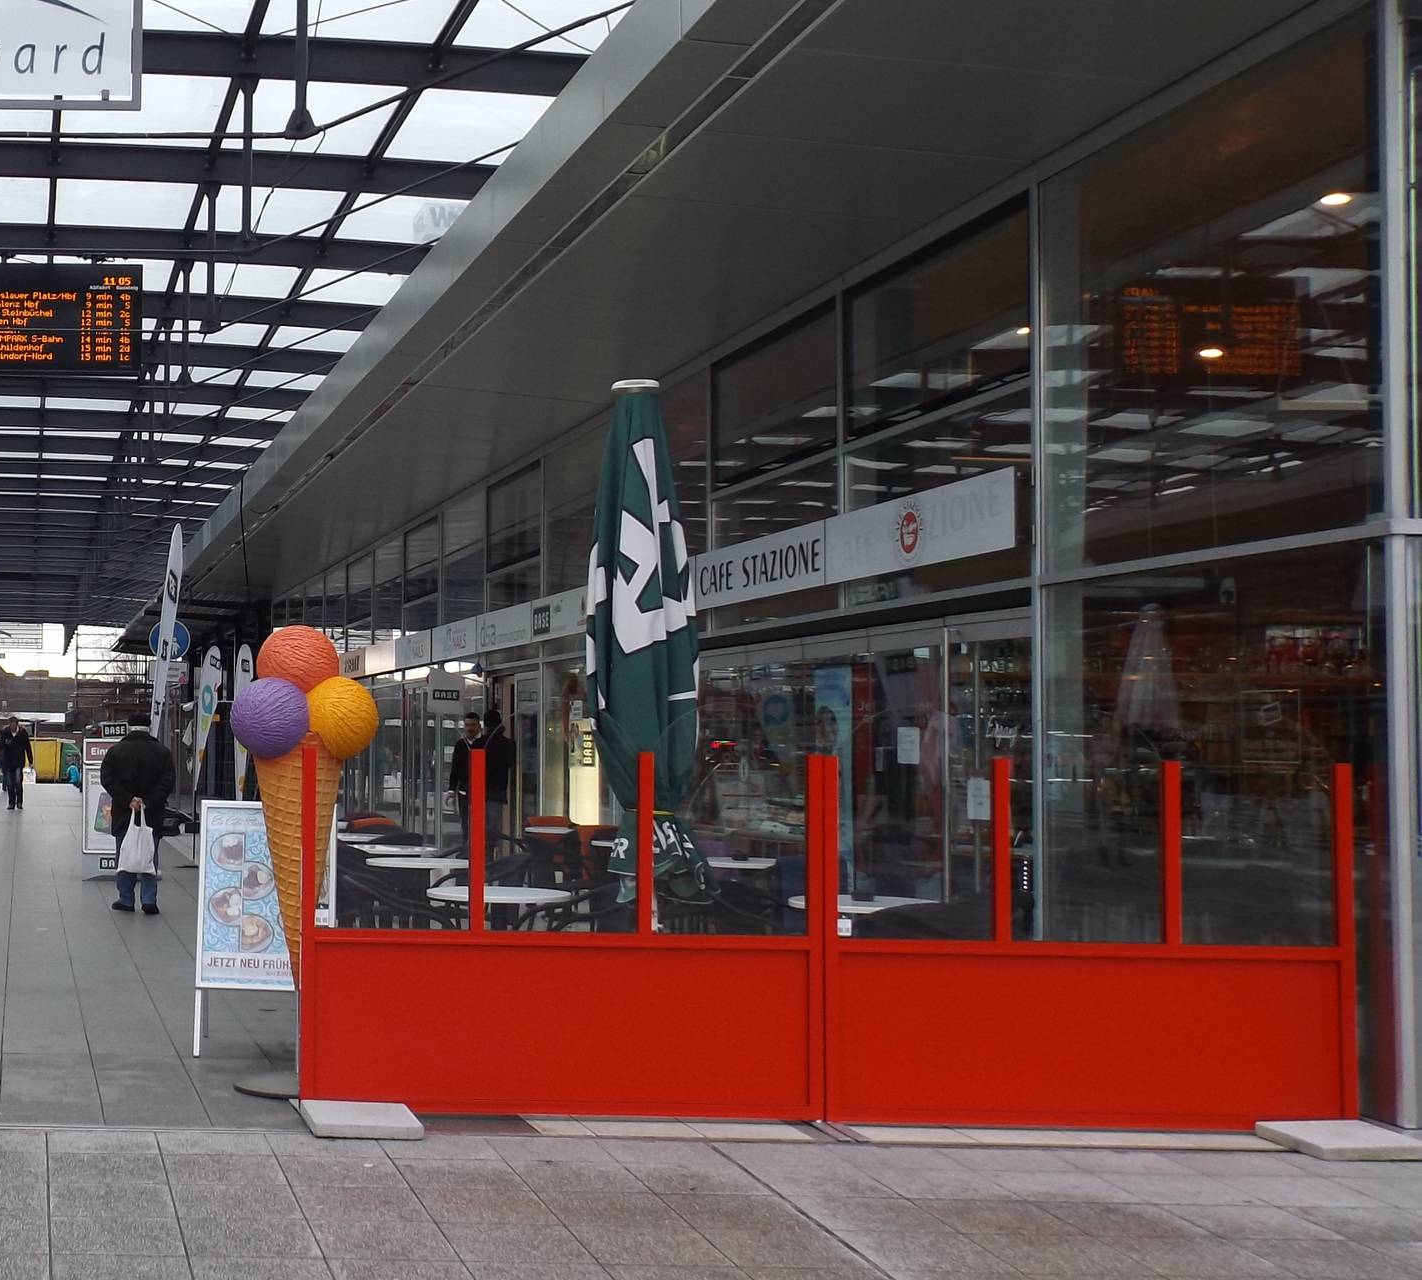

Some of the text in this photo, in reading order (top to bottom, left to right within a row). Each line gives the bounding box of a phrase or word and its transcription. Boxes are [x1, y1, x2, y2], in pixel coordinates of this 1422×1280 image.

[33, 292, 77, 301] Platz/Hbf
[24, 301, 39, 309] Hbf
[13, 318, 27, 326] Hbf
[699, 537, 821, 597] CAFE STAZIONE
[534, 611, 550, 631] BASE
[434, 690, 458, 699] BASE
[104, 725, 127, 736] BASE
[583, 734, 593, 765] BASE
[101, 858, 116, 868] BA
[207, 957, 292, 970] JETZT NEU FRÜH
